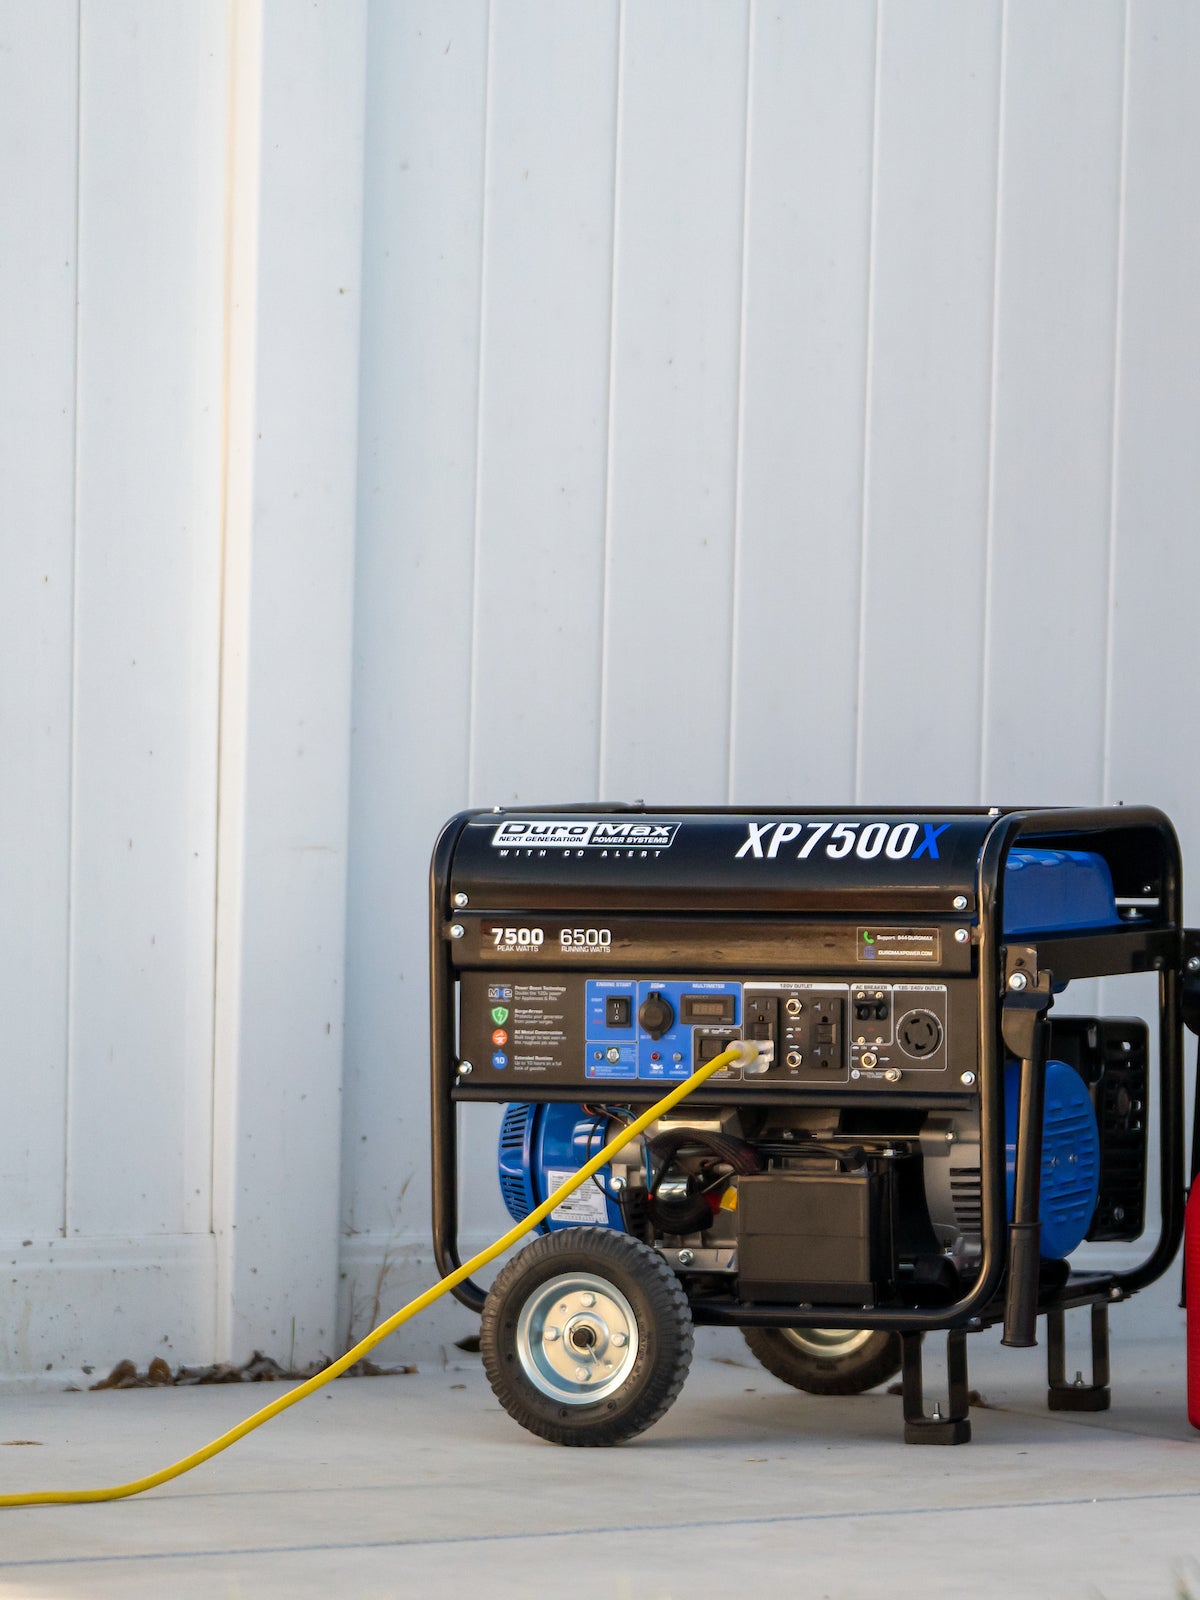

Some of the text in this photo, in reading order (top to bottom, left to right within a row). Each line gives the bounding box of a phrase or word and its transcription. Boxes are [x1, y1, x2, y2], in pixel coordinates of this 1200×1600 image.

[734, 822, 952, 859] XP7500X
[491, 928, 544, 945] 7500
[560, 928, 611, 946] 6500
